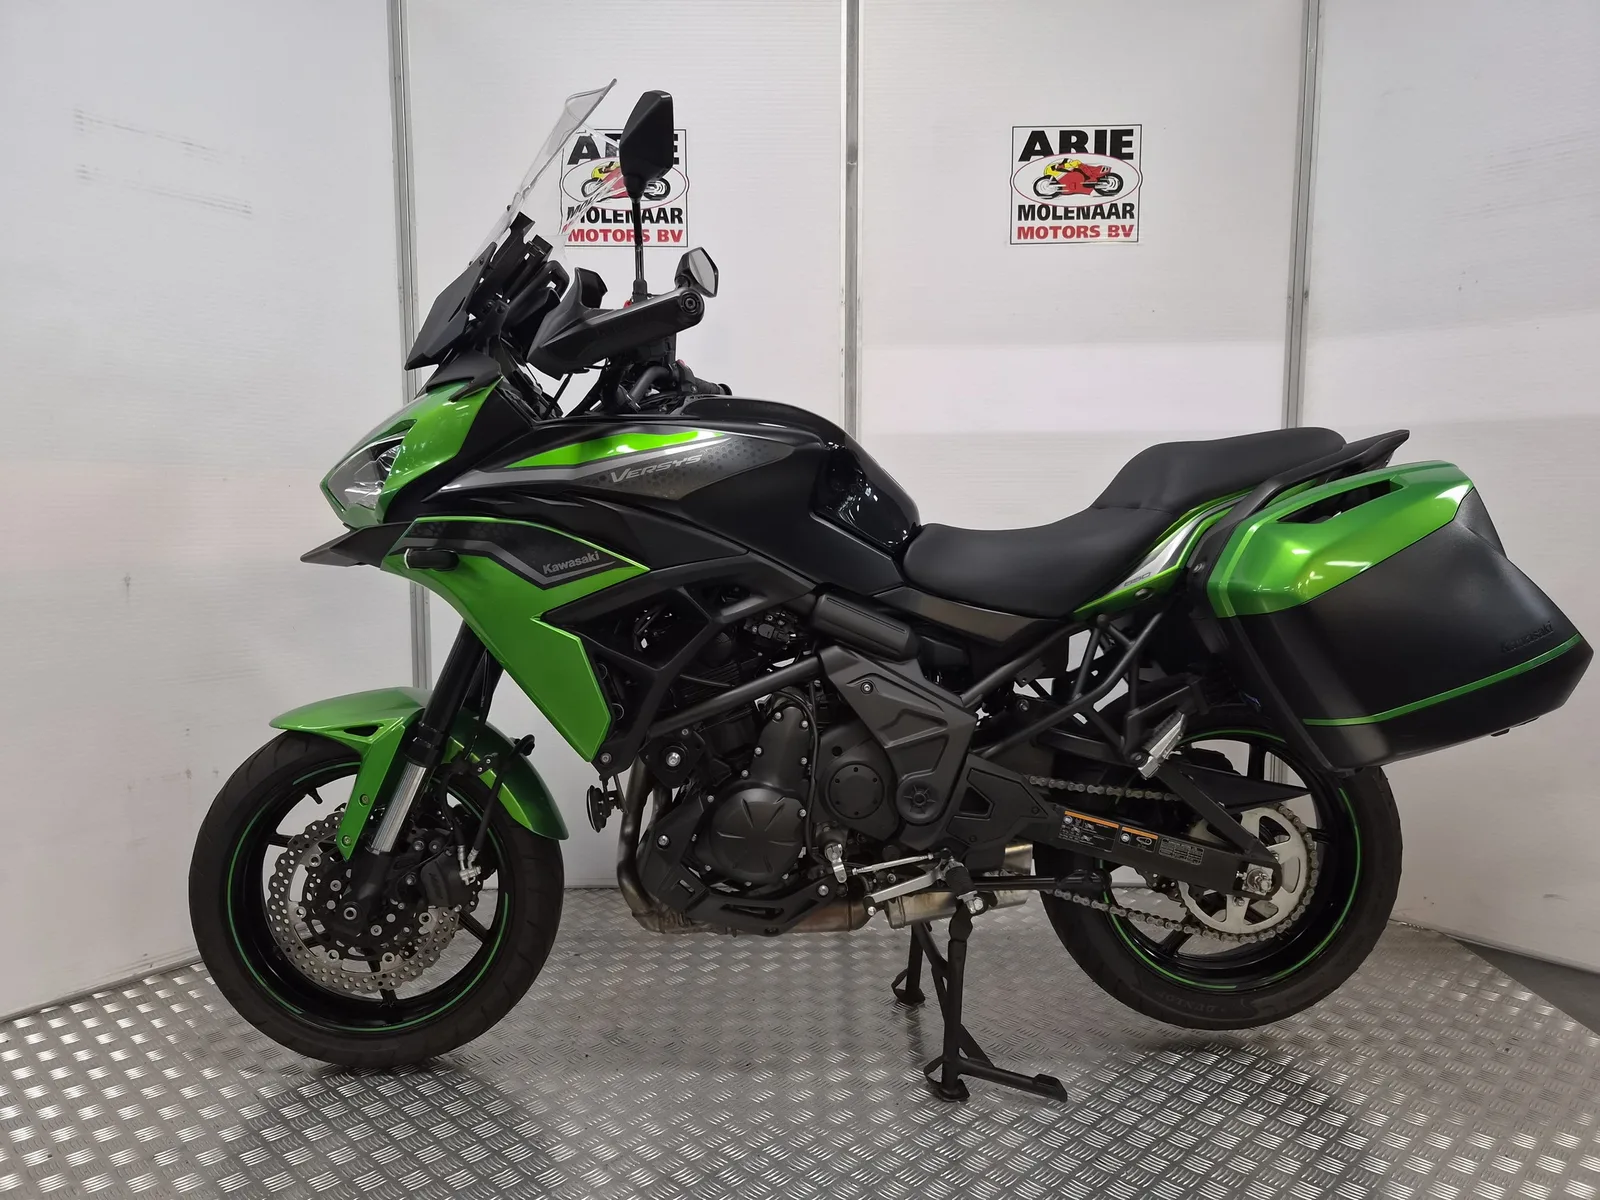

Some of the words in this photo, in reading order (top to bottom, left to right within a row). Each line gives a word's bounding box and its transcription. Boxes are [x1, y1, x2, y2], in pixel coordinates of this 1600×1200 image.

[1018, 129, 1134, 162] ARIE
[1017, 203, 1135, 221] MOLENAAR
[657, 229, 684, 243] BV
[1017, 225, 1101, 240] MOTORS
[1107, 224, 1135, 238] BV
[543, 550, 600, 575] Kawasaki
